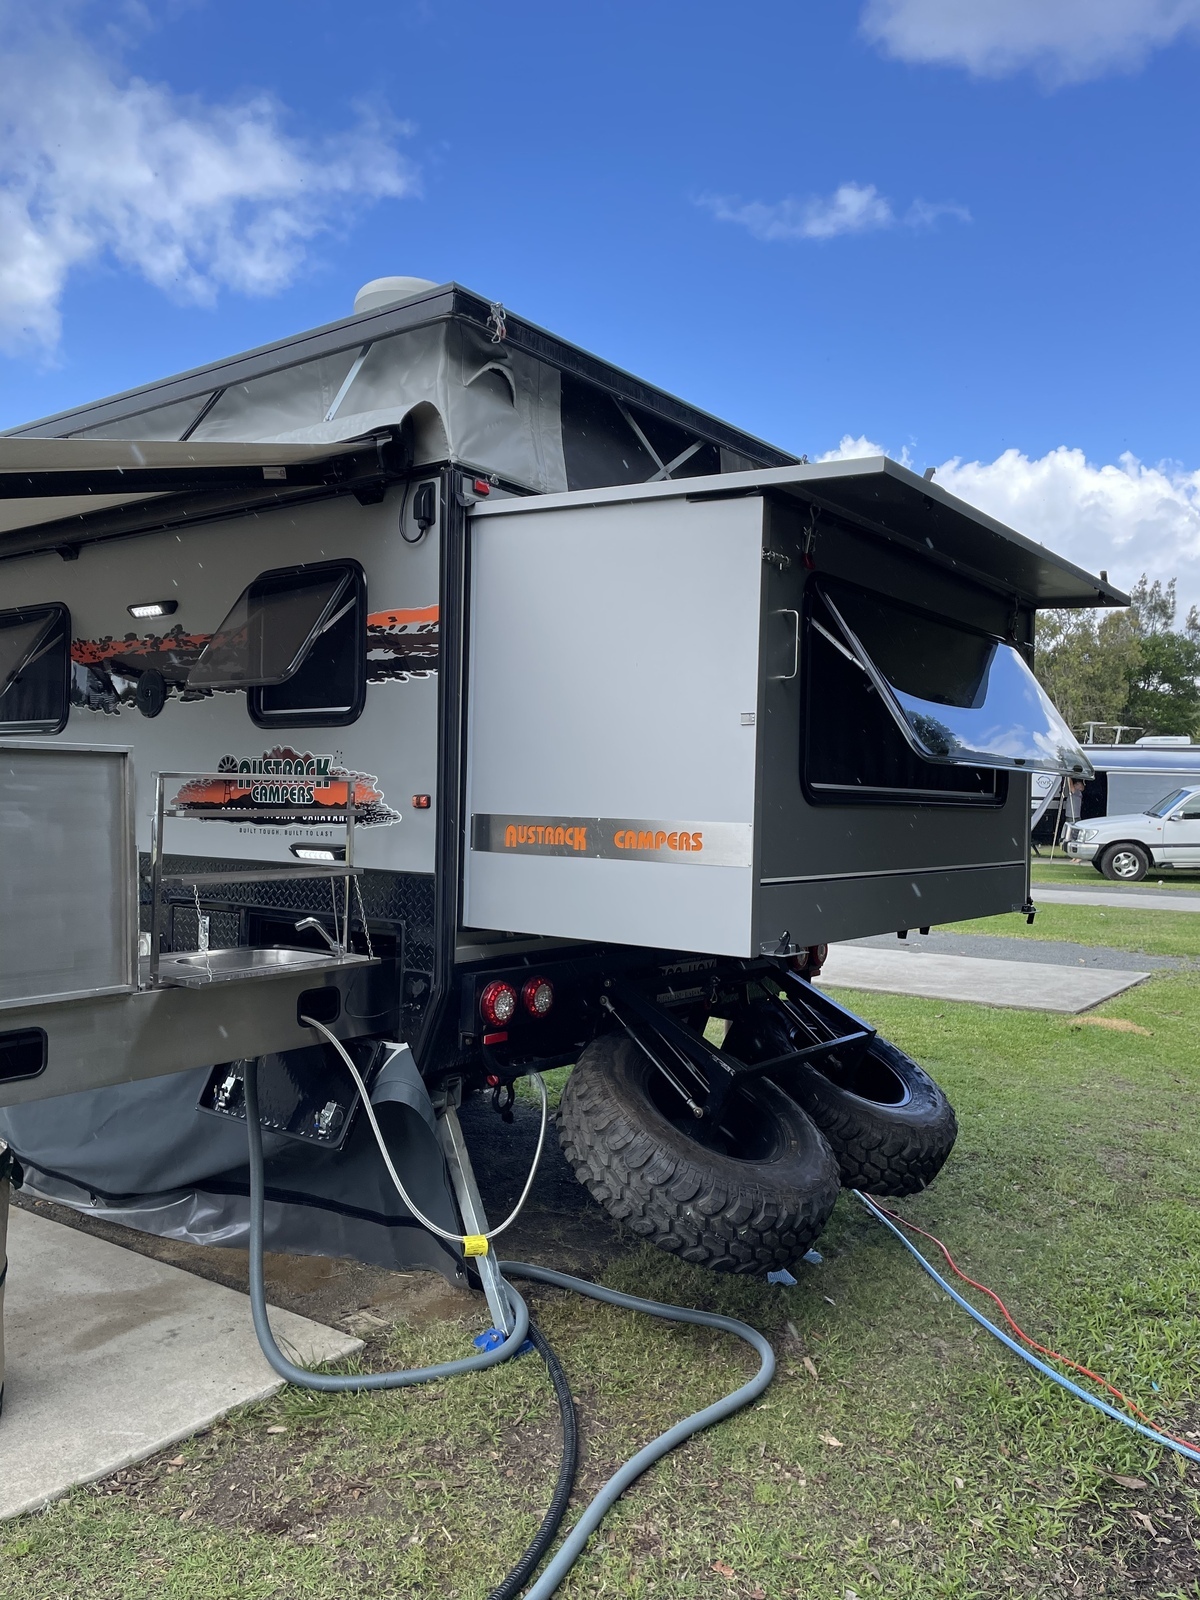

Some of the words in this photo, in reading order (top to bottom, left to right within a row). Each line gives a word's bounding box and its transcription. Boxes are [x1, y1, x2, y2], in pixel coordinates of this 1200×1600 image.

[238, 758, 331, 788] AUSTRACK
[251, 785, 315, 804] CAMPERS
[505, 824, 587, 850] AUSTRACK
[613, 829, 703, 852] CAMPERS
